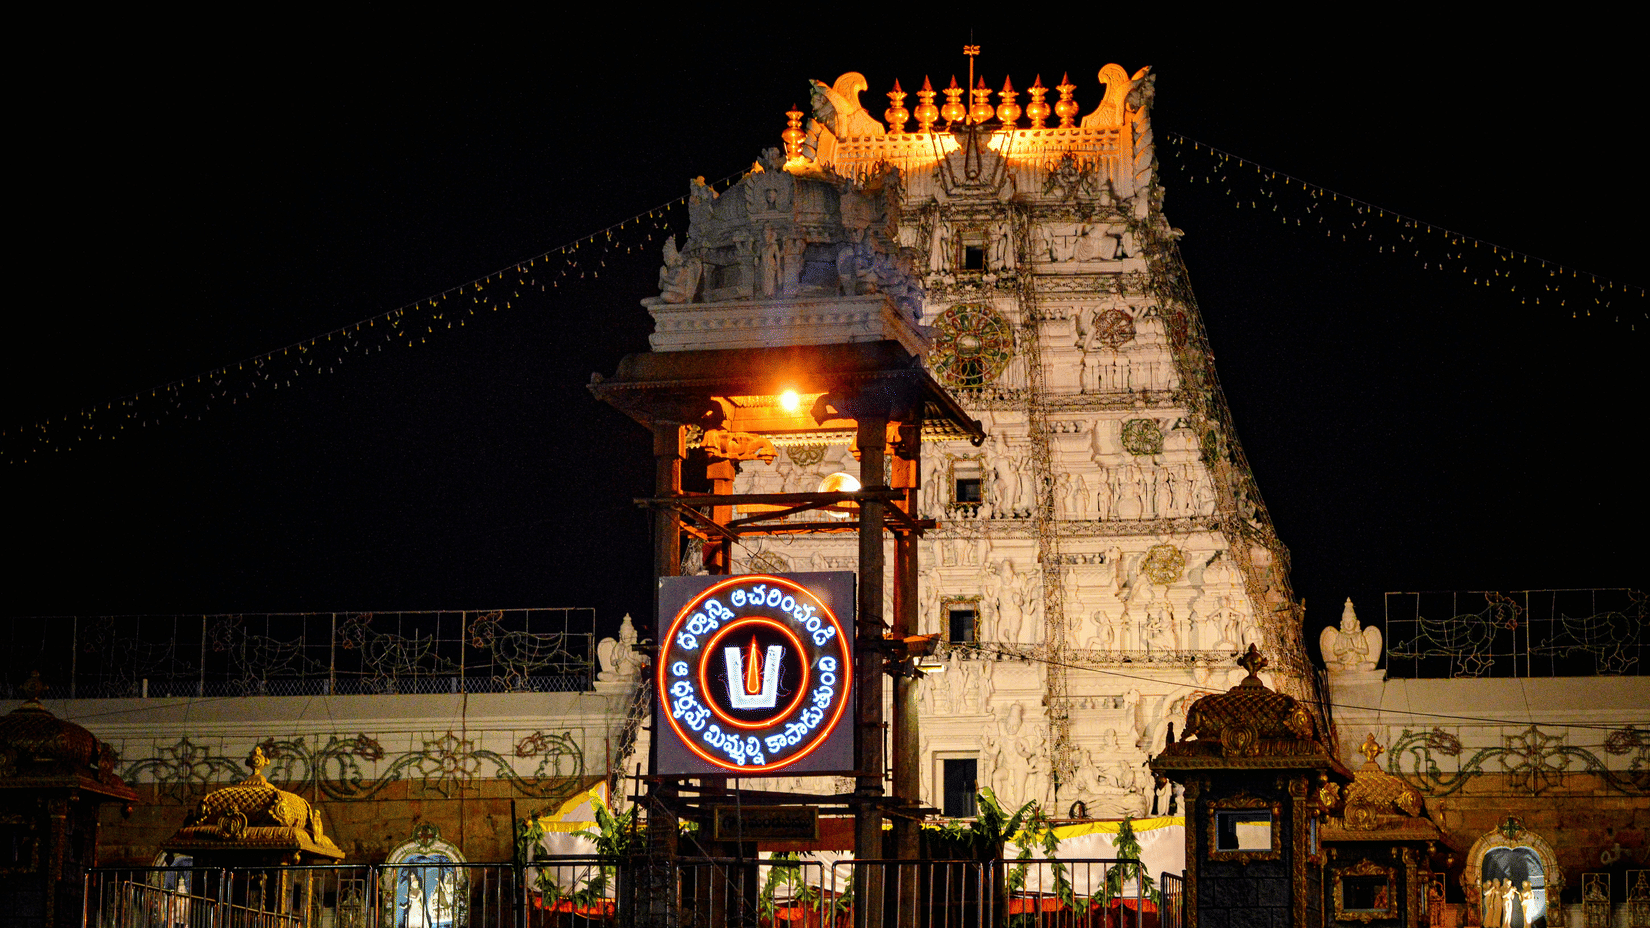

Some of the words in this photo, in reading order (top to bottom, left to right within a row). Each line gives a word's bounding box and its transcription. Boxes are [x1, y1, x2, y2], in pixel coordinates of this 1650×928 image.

[676, 598, 735, 650] ధర్మాన్ని
[730, 584, 836, 646] ఆచరించండి
[672, 660, 689, 677] ఆ
[669, 680, 711, 731] ధర్మమే
[764, 656, 837, 754] కాపాడుతుంది
[703, 724, 766, 766] మిమ్మల్ని
